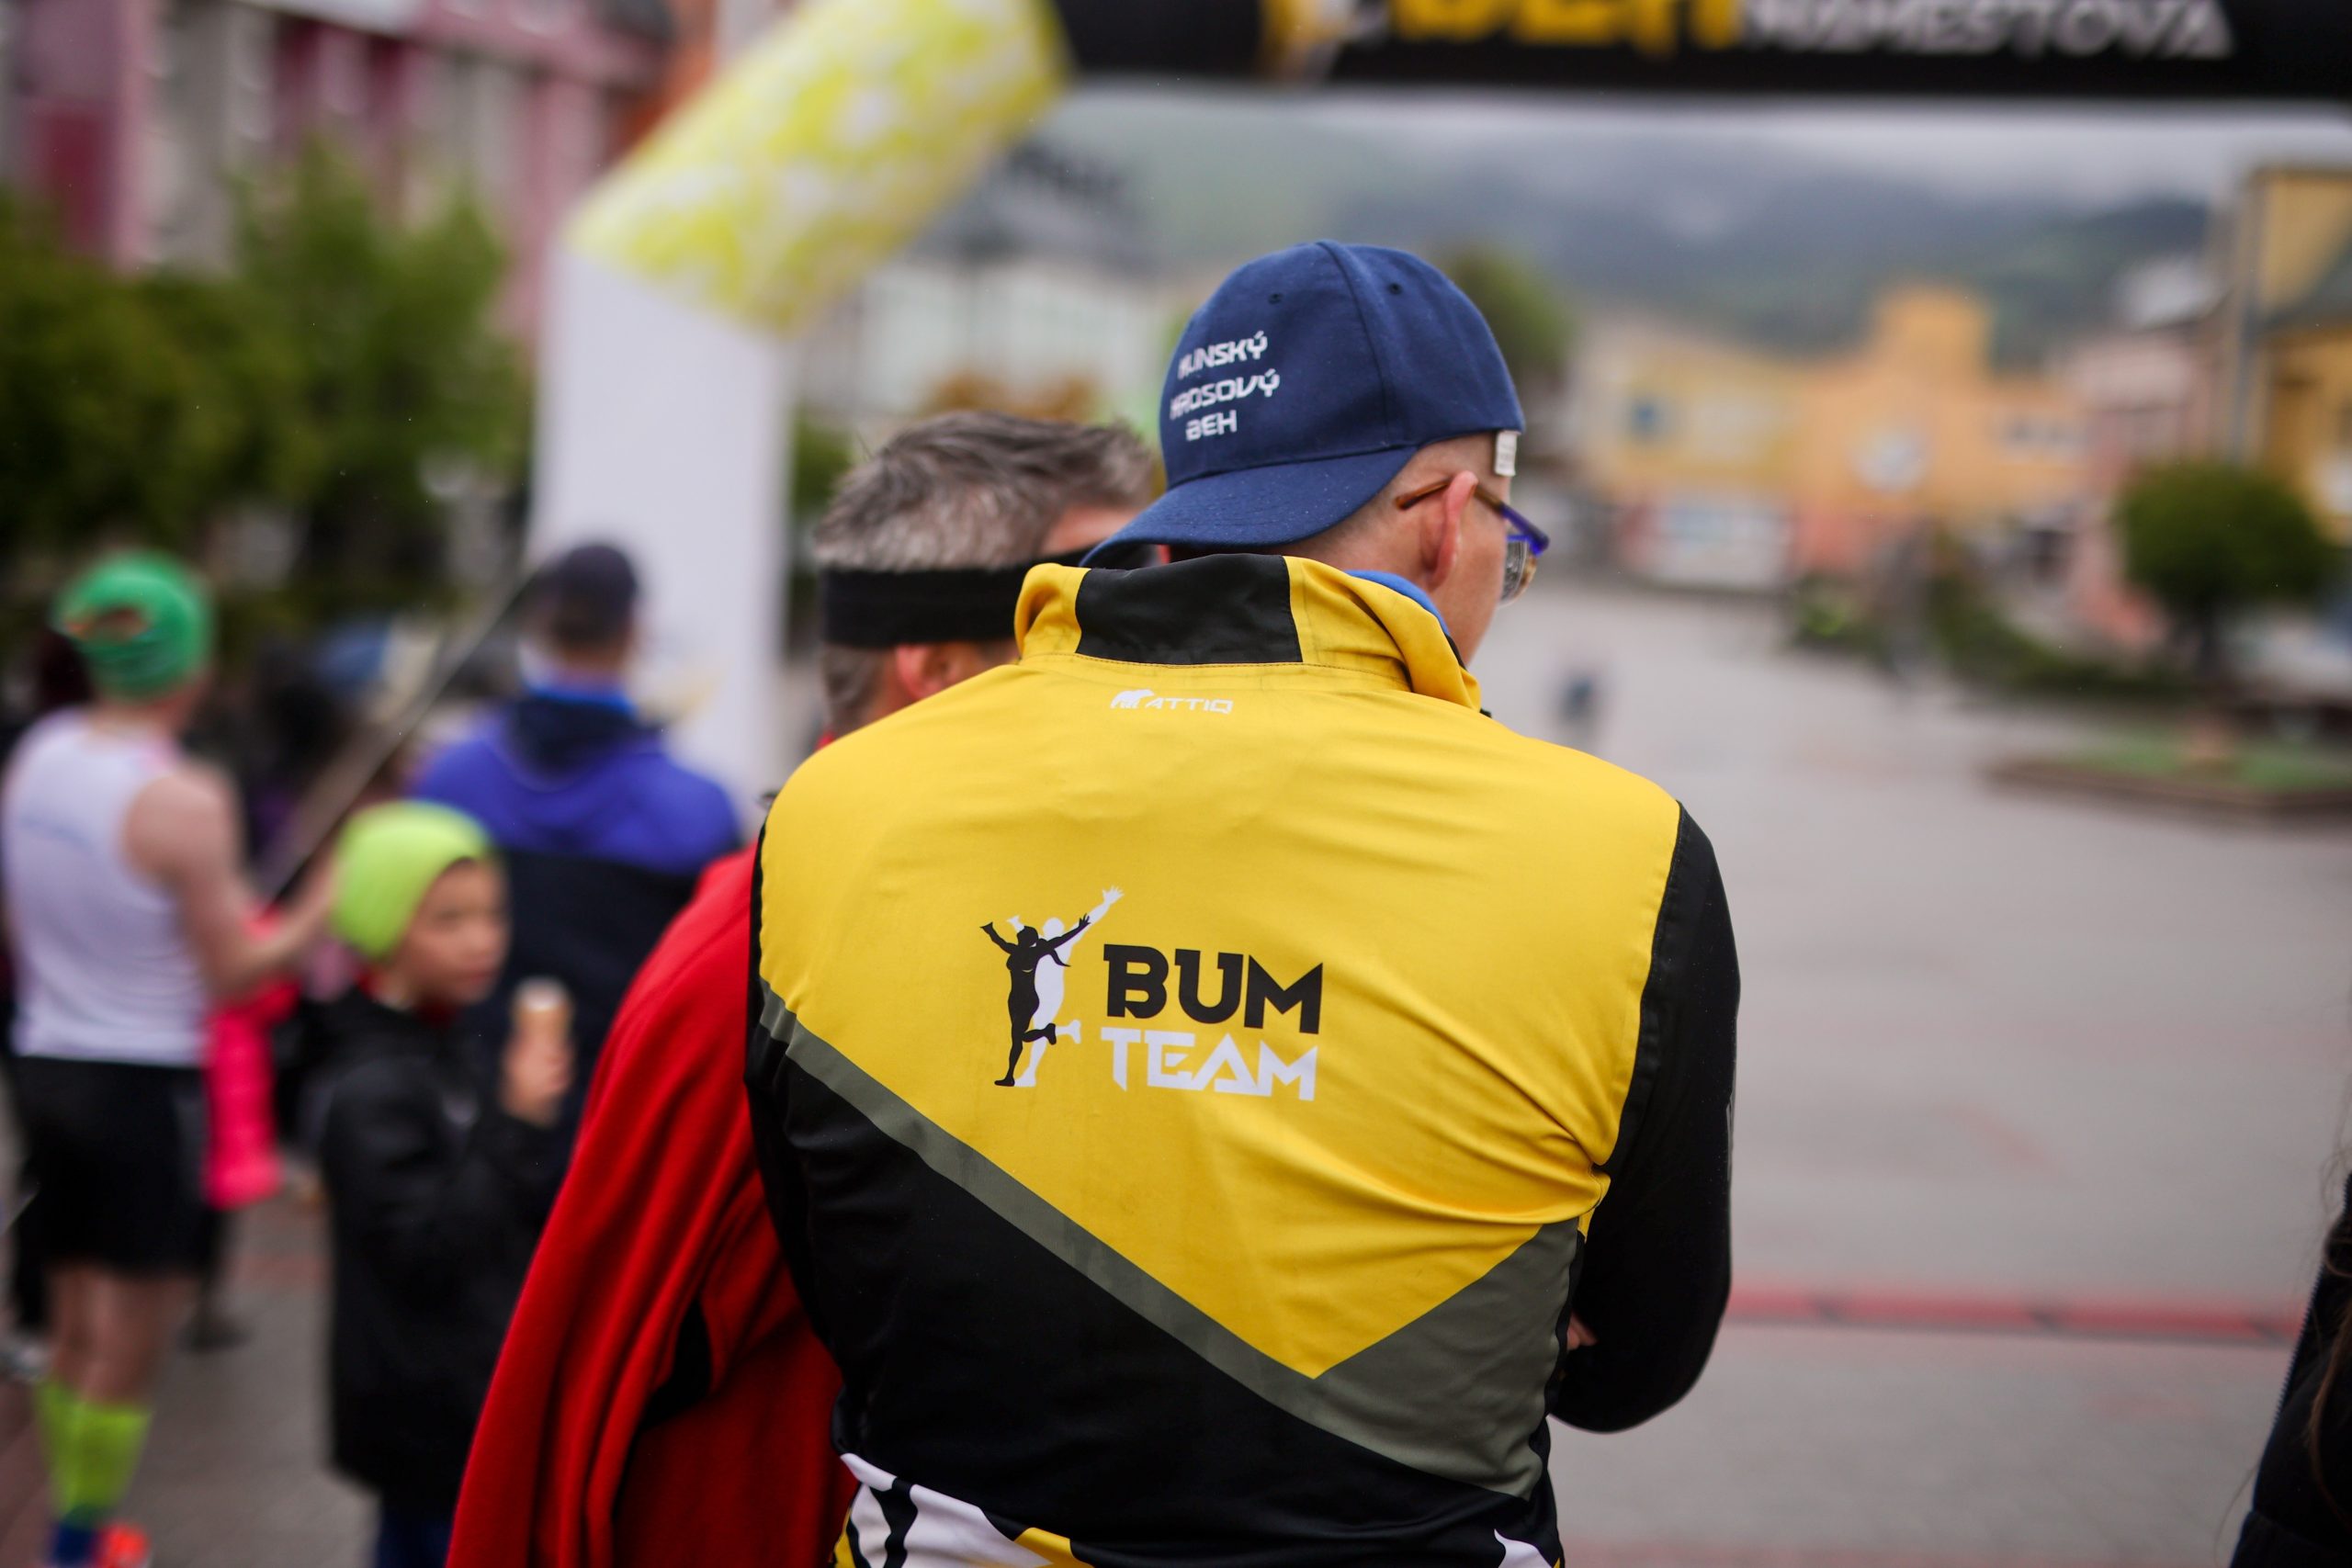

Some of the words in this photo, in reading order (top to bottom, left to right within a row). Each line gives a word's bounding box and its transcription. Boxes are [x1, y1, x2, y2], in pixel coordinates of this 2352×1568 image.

[1185, 409, 1238, 442] BEH
[1145, 696, 1234, 714] ATTIQ
[1103, 943, 1323, 1034] BUM
[1101, 1026, 1317, 1101] TEAM
